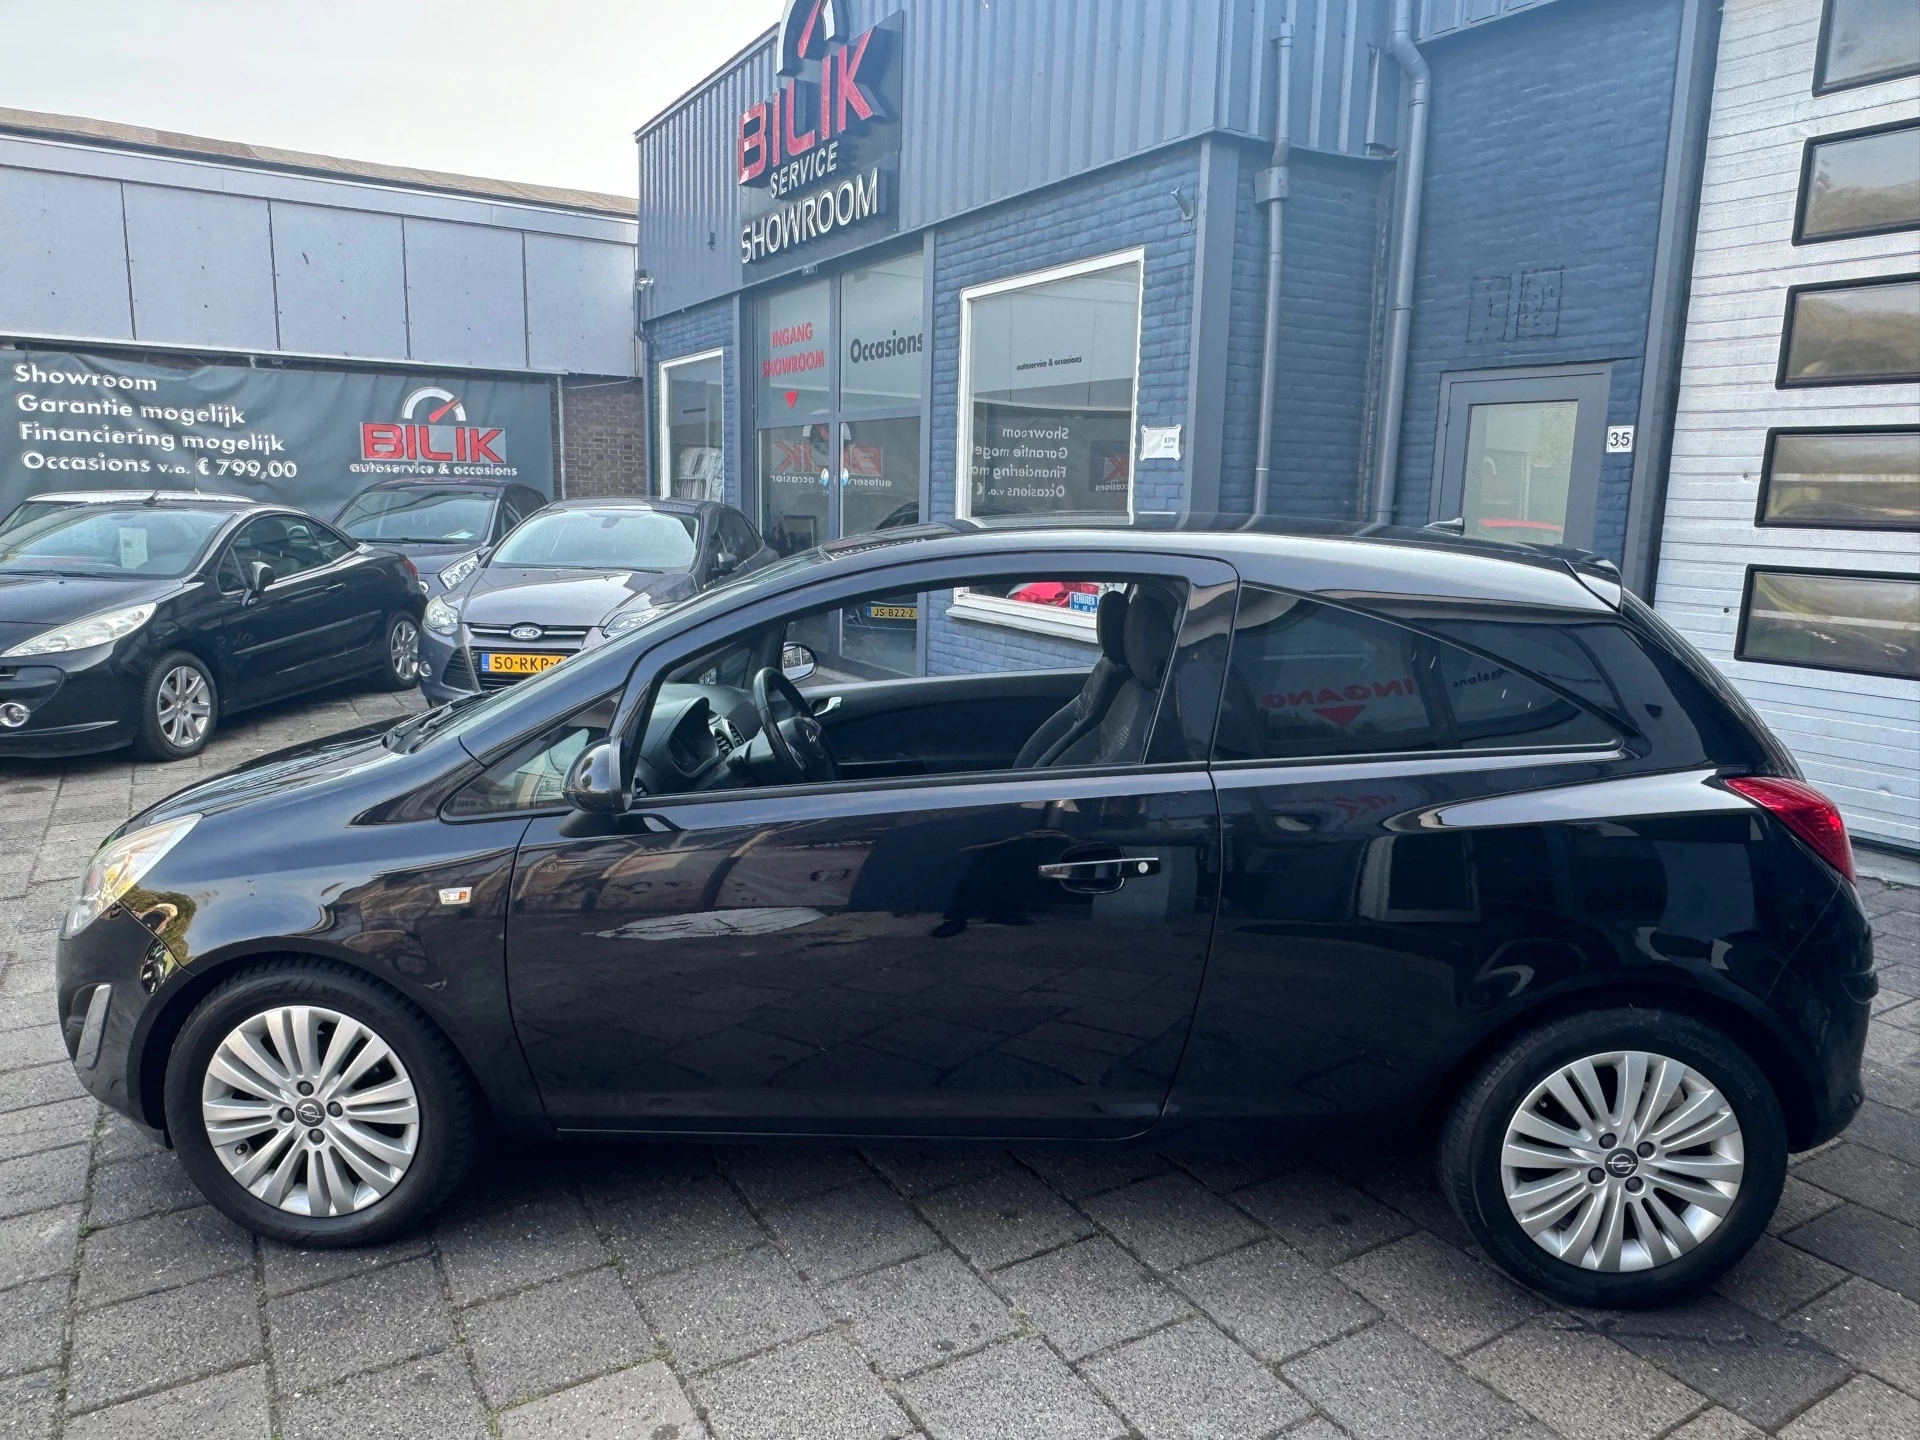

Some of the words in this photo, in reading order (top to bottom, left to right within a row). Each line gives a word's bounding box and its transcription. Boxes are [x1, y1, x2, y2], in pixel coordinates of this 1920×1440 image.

[738, 26, 874, 185] BILIK
[770, 141, 838, 199] SERVICE
[742, 167, 877, 264] SHOWROOM
[772, 322, 813, 348] INGANG
[850, 329, 922, 364] Occasions
[14, 363, 157, 391] Showroom
[762, 350, 825, 378] SHOWROOM
[18, 393, 133, 417] Garantie
[140, 403, 246, 427] mogelijk
[20, 422, 175, 451] Financiering
[182, 433, 286, 455] mogelijk
[363, 422, 505, 464] BILIK
[1610, 431, 1631, 449] 35
[22, 451, 151, 473] Occasions
[157, 463, 190, 474] v.a.
[197, 457, 210, 476] €
[216, 459, 297, 480] 799,00
[350, 461, 435, 475] autoservice
[438, 463, 450, 475] &
[453, 464, 518, 476] occasions
[494, 656, 562, 671] 50-RKP-
